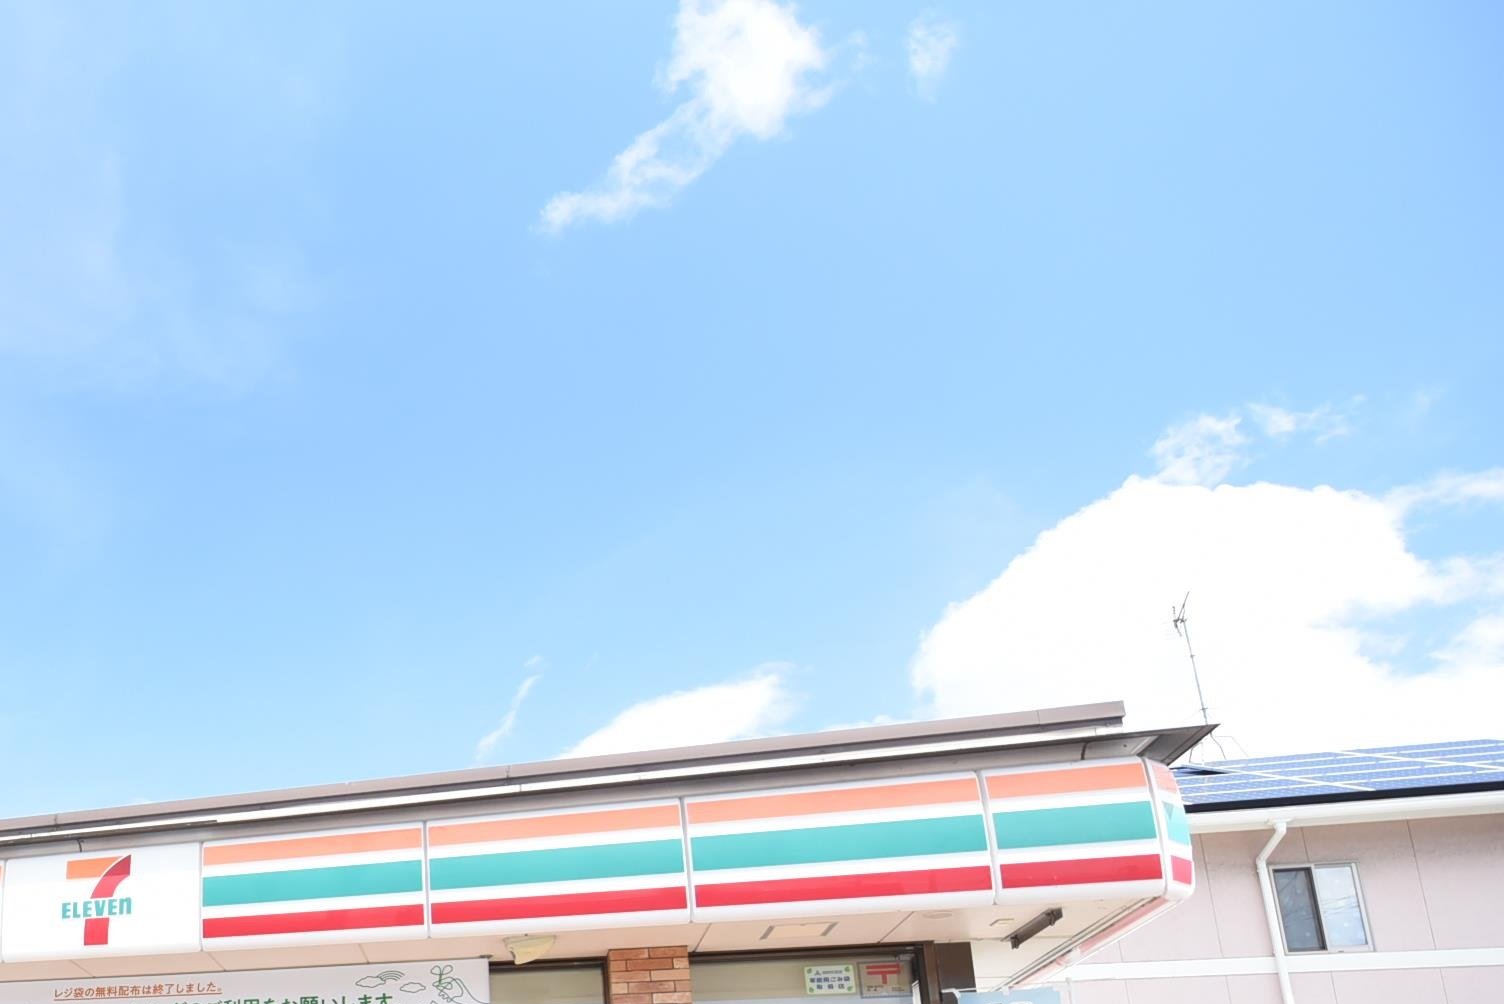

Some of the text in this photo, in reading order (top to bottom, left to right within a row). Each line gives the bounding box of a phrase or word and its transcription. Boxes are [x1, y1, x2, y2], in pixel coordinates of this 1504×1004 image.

[54, 981, 223, 998] レジ袋の無料配布は終了しました。
